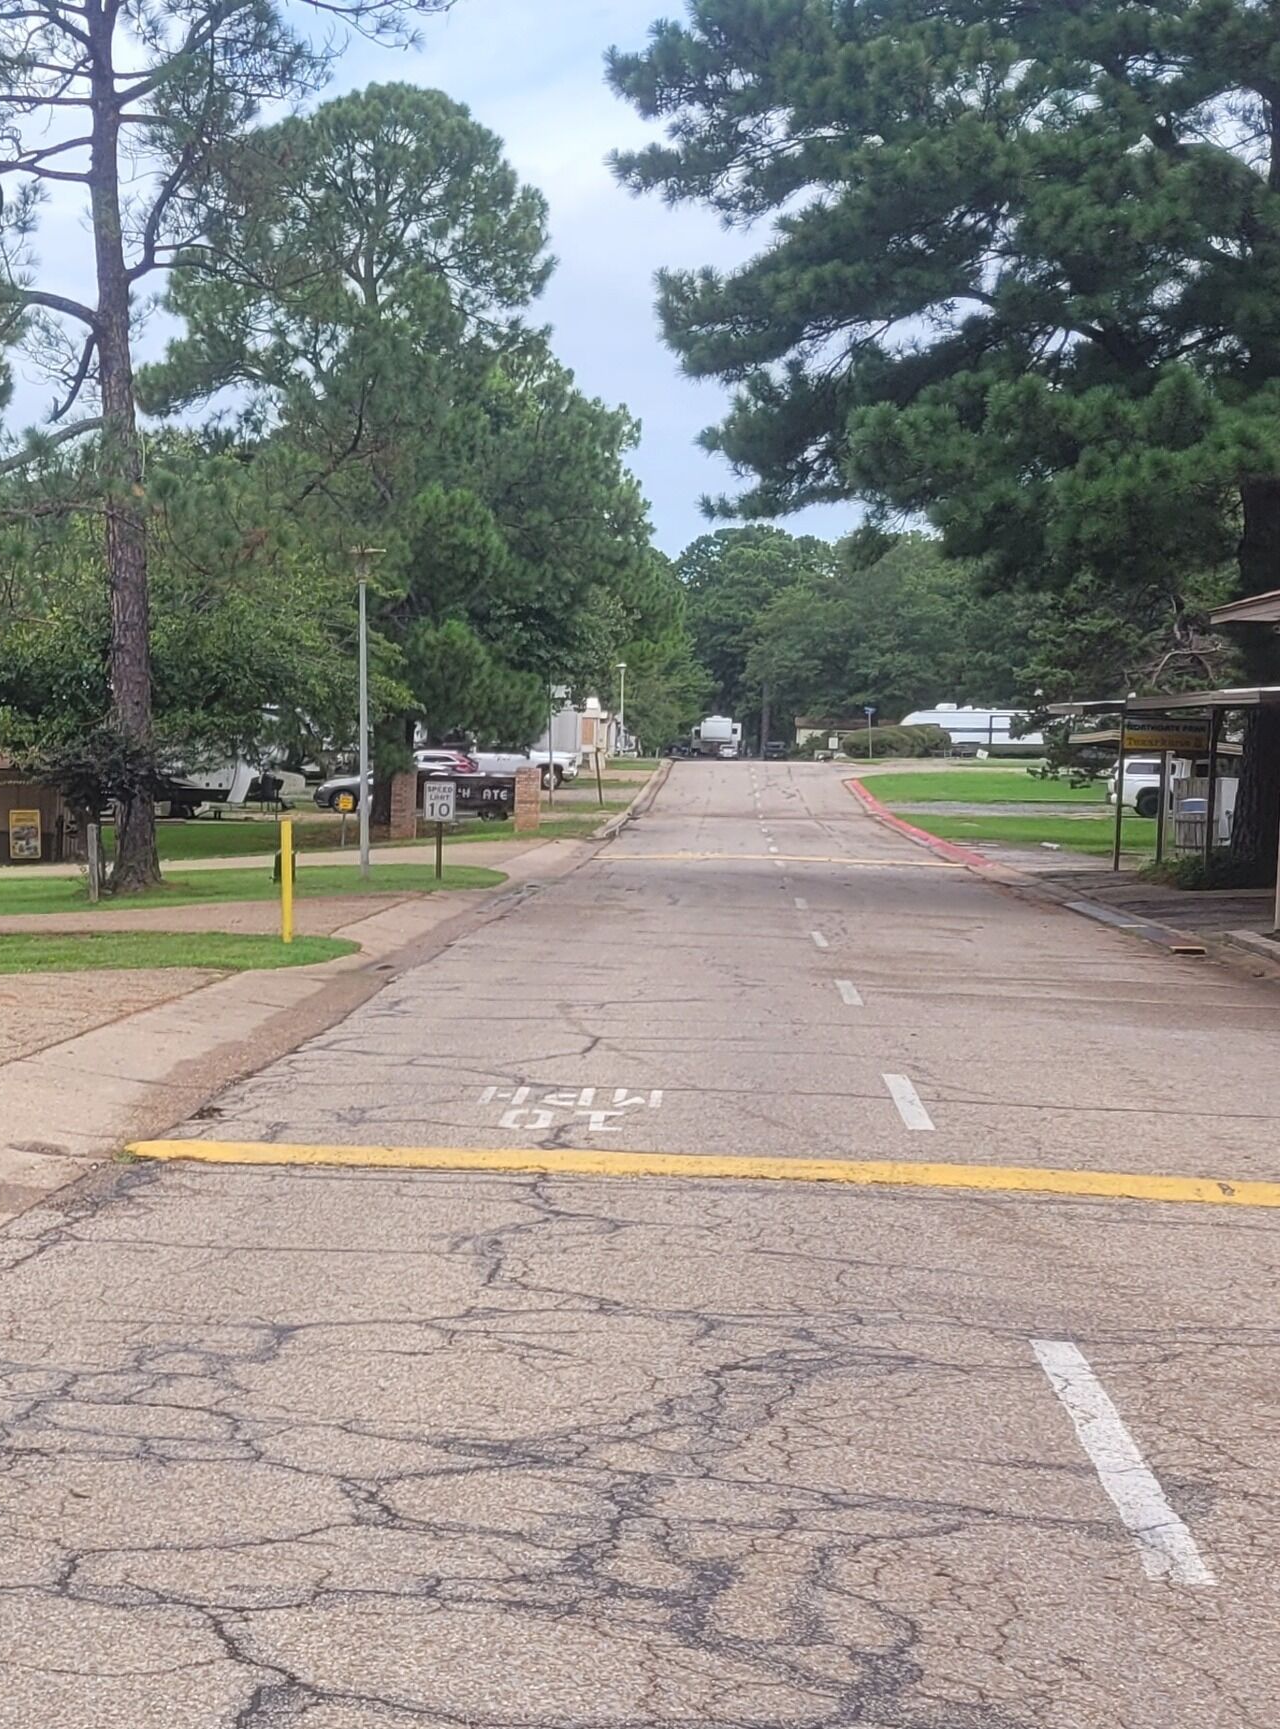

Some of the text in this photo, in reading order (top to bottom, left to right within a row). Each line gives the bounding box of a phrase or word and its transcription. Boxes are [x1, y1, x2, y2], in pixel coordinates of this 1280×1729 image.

[429, 803, 450, 817] 10
[478, 1086, 664, 1108] MPH
[498, 1108, 625, 1132] 10
